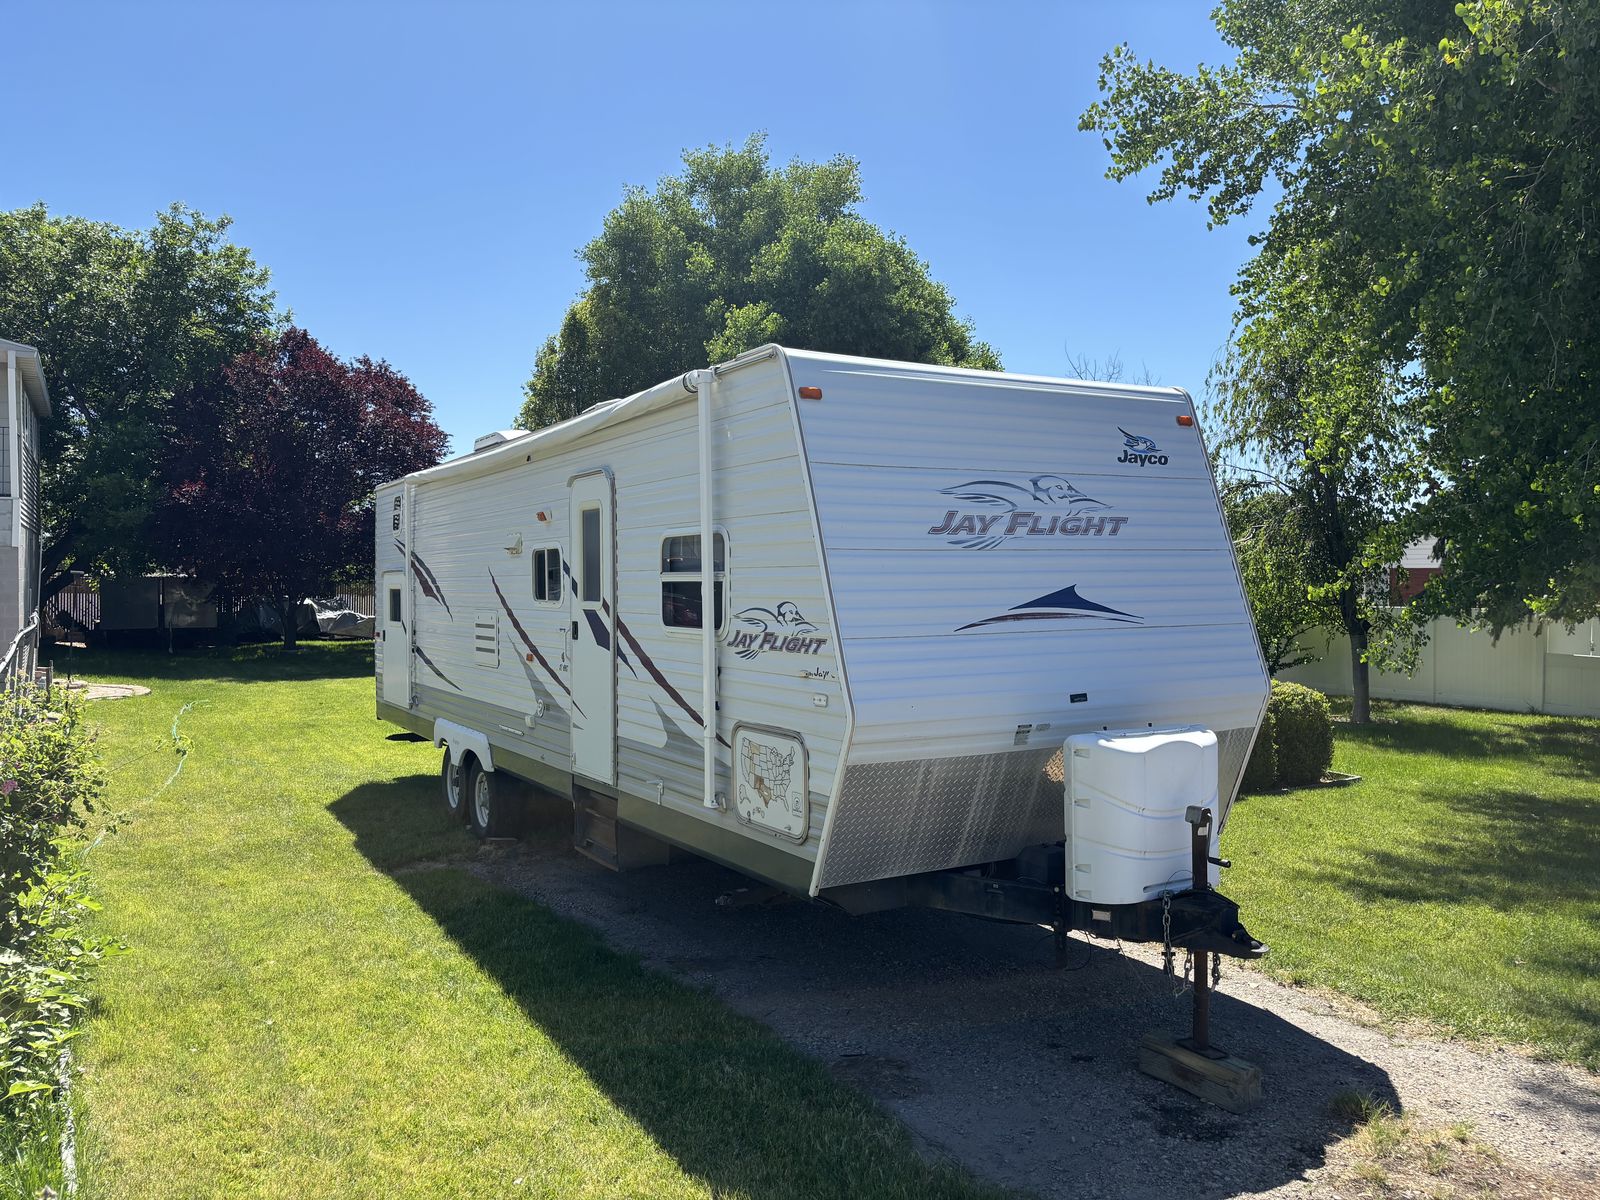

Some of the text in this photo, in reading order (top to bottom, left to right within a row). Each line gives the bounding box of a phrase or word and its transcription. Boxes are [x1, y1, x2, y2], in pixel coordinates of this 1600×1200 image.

[1117, 450, 1169, 467] Jayco
[928, 510, 1129, 537] JAY FLIGHT
[727, 629, 828, 655] JAY FLIGHT
